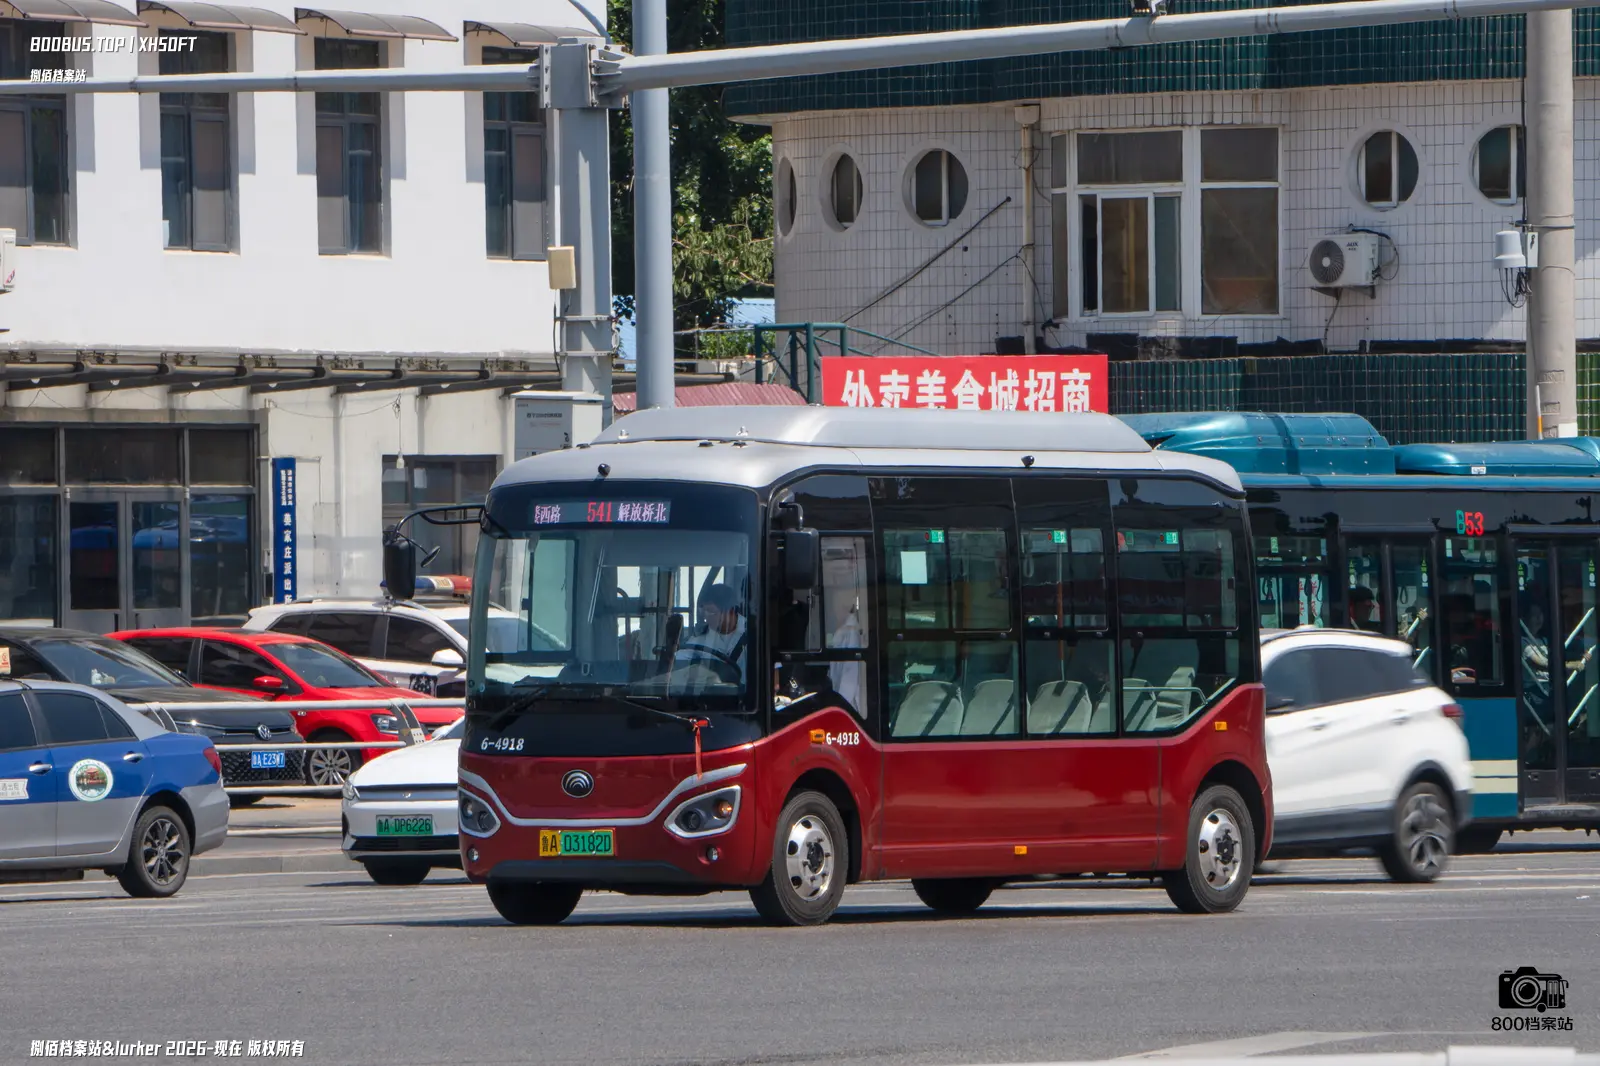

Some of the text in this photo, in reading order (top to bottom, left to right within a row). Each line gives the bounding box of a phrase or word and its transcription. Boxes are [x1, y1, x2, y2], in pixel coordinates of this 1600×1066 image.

[840, 368, 1092, 412] 外卖美食城招商
[587, 501, 613, 523] 541
[617, 502, 667, 523] 解放桥北
[1456, 509, 1485, 536] B53
[480, 736, 525, 751] 6-4918
[825, 731, 860, 746] 6-4918
